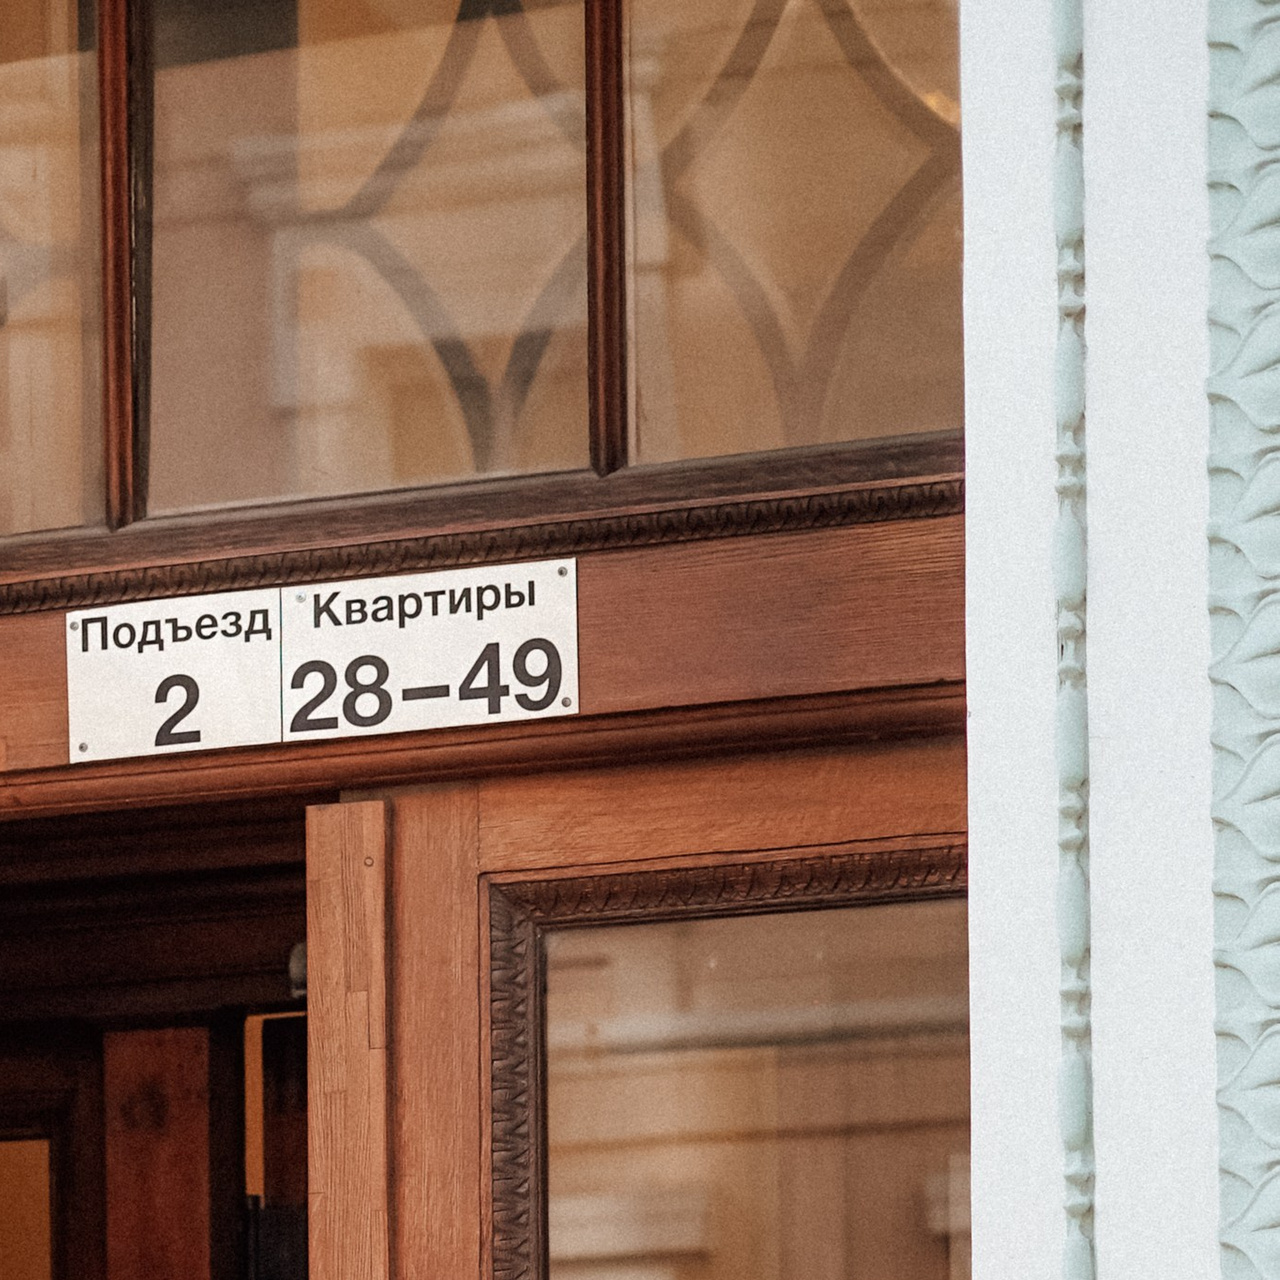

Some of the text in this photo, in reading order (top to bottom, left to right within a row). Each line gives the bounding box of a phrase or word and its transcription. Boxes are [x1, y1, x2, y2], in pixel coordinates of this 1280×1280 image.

[312, 579, 536, 629] Квартиры
[80, 607, 272, 653] Подъезд
[153, 673, 202, 747] 2
